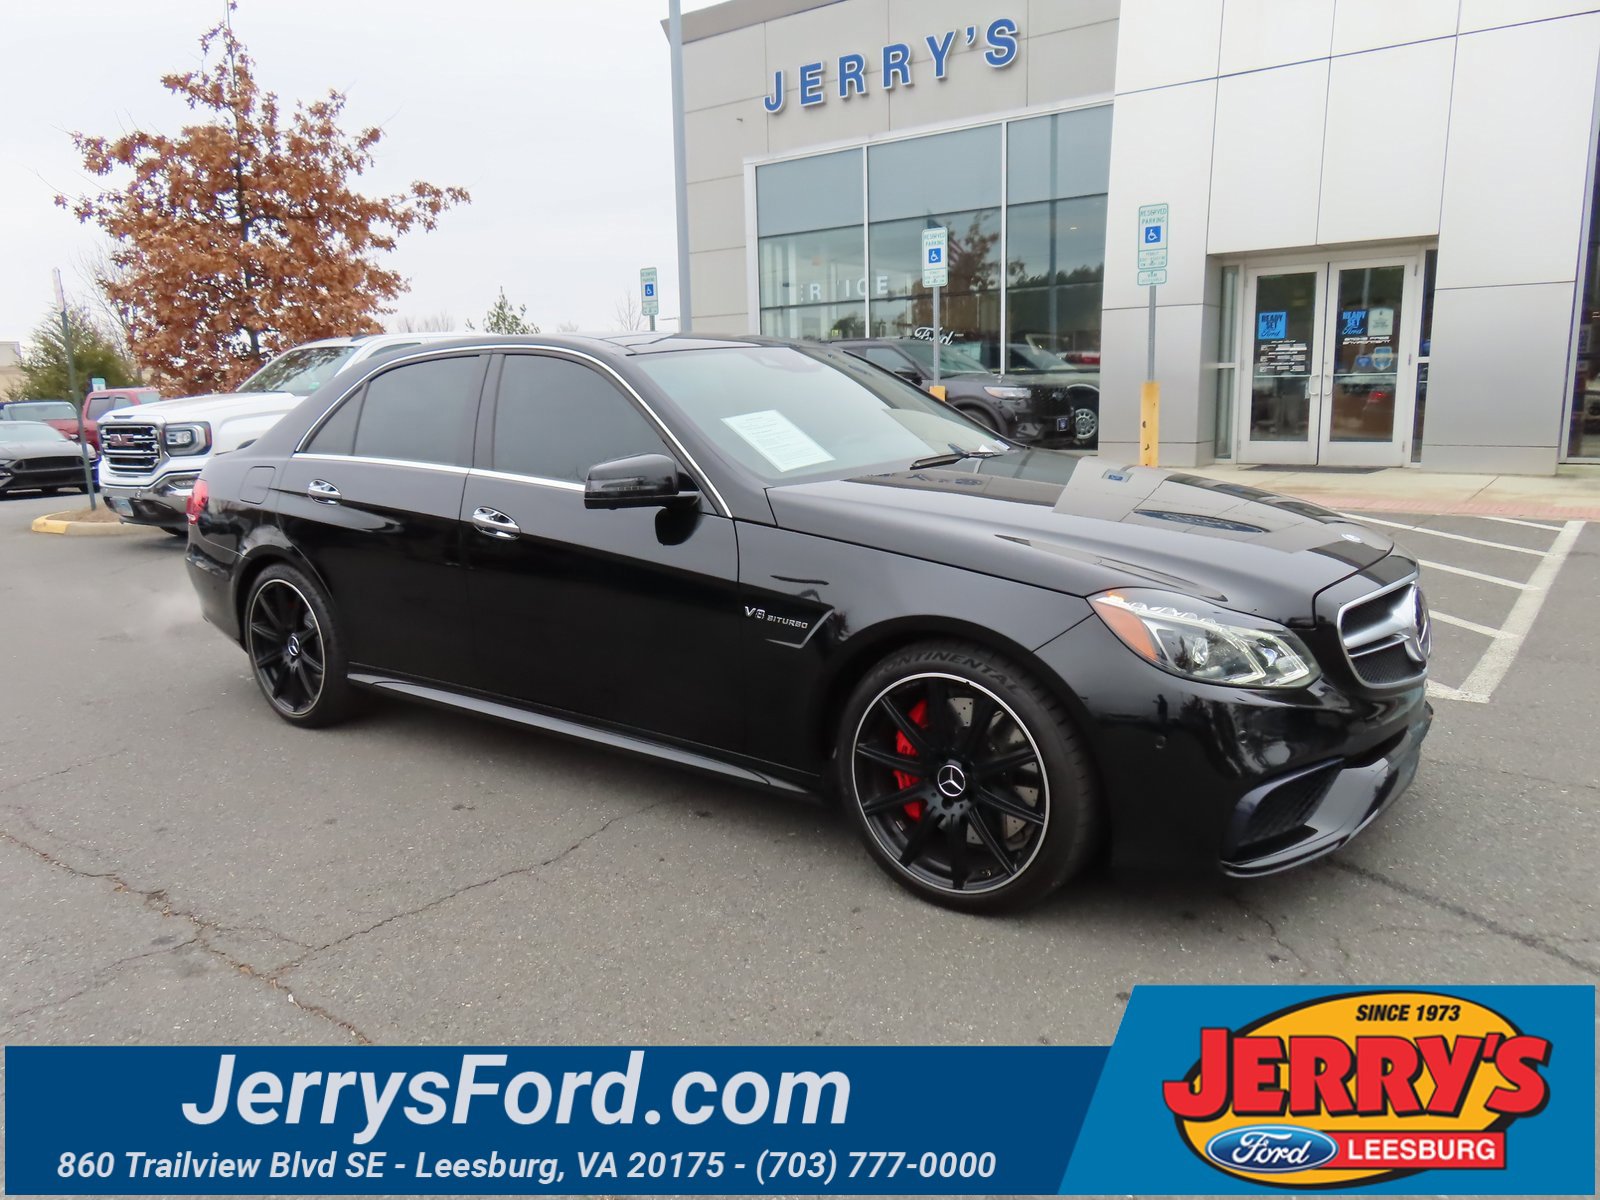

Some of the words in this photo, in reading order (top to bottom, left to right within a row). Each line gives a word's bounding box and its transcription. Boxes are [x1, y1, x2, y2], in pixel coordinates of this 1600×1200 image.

[763, 18, 1018, 113] JERRY'S
[913, 327, 954, 346] Fod
[744, 606, 766, 619] V8
[767, 614, 808, 629] BITURBO
